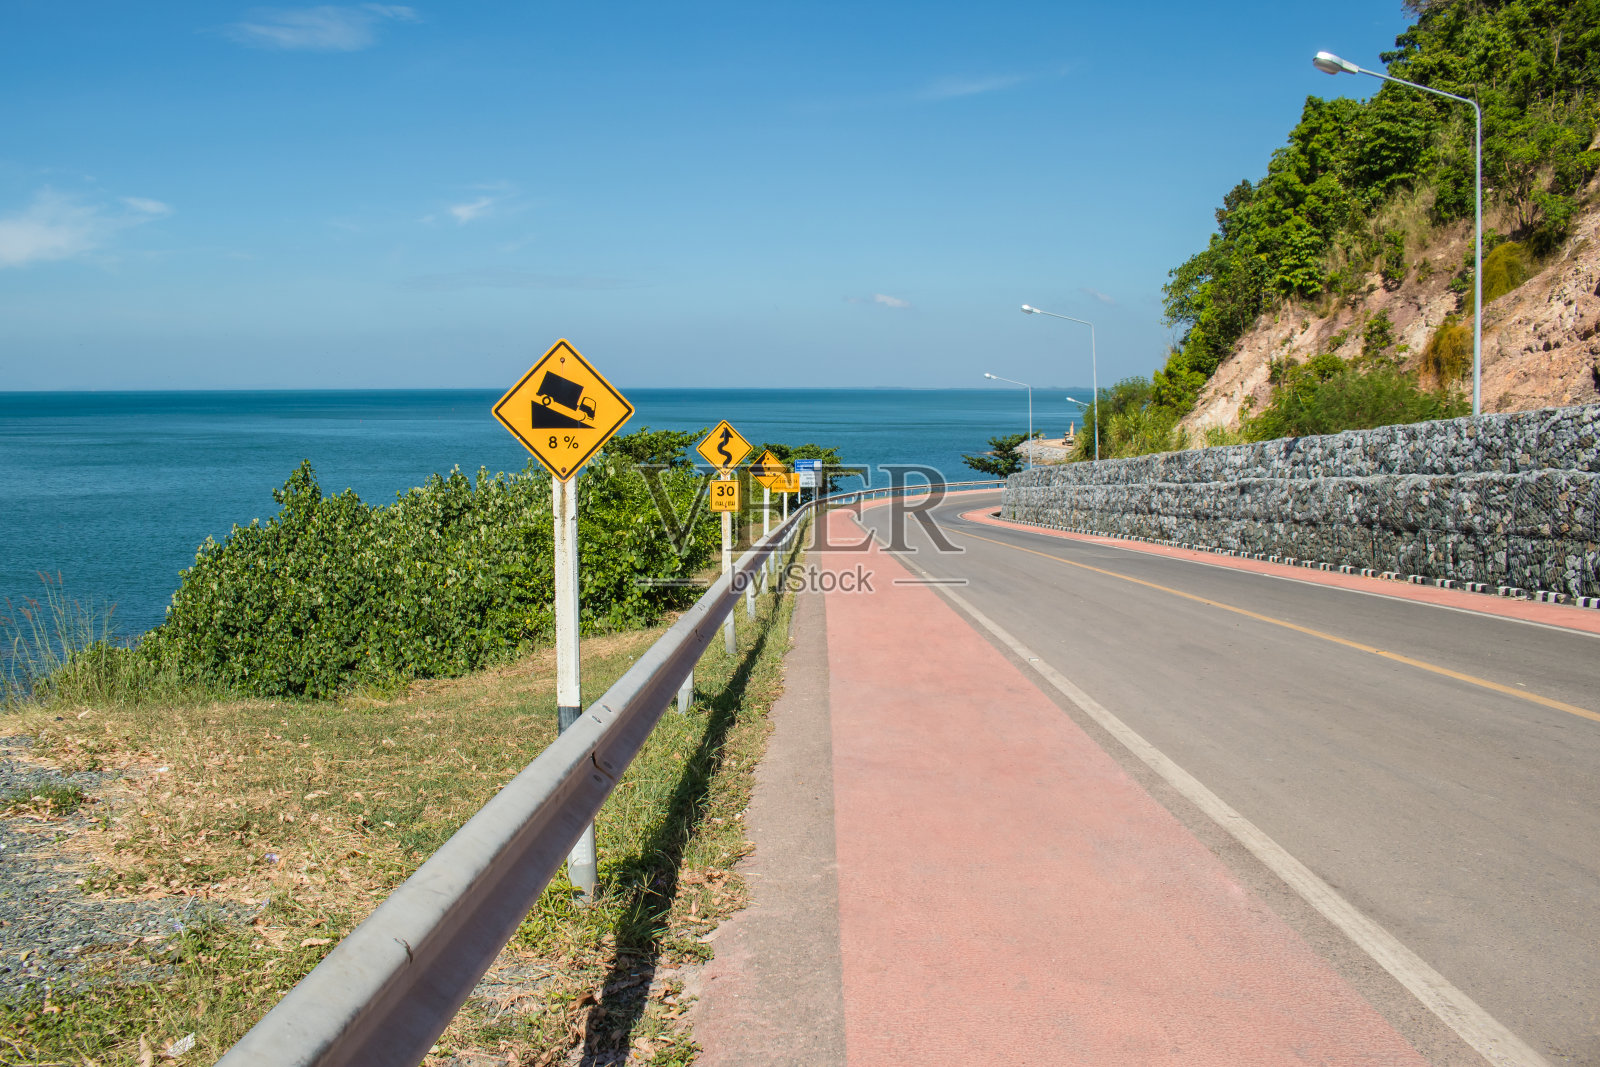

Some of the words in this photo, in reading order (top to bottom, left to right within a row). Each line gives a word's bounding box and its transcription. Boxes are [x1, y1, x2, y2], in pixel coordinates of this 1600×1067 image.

[548, 436, 558, 449] 8
[563, 435, 579, 449] %
[716, 486, 735, 497] 30
